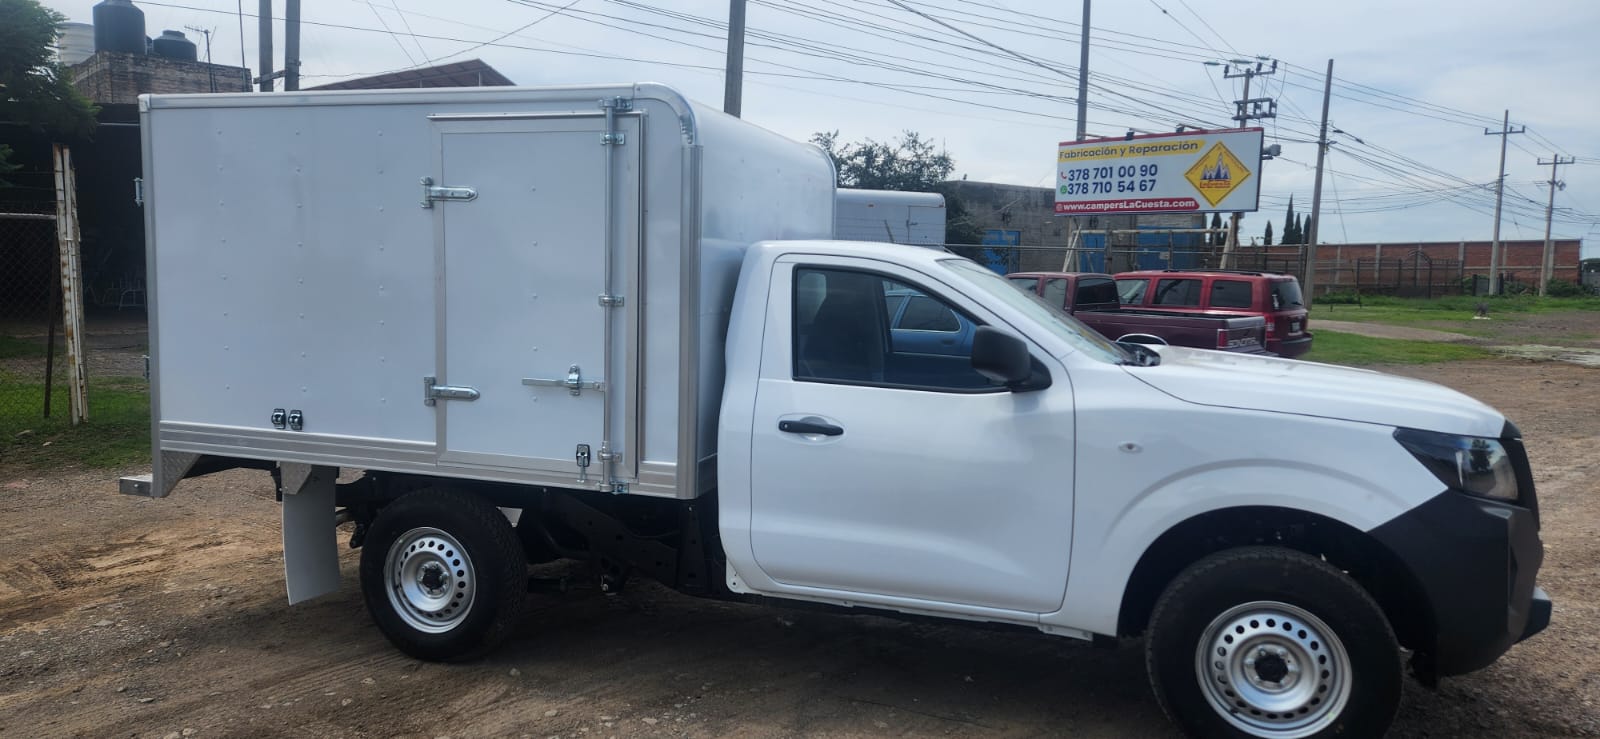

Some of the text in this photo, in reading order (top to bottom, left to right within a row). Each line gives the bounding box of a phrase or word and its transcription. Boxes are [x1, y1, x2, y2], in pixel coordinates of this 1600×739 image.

[1060, 140, 1198, 159] Fabricación y Reparación
[1068, 164, 1158, 182] 378 701 00 90
[1067, 179, 1156, 195] 378 710 54 67
[1063, 200, 1195, 210] www.campersLaCuesta.com
